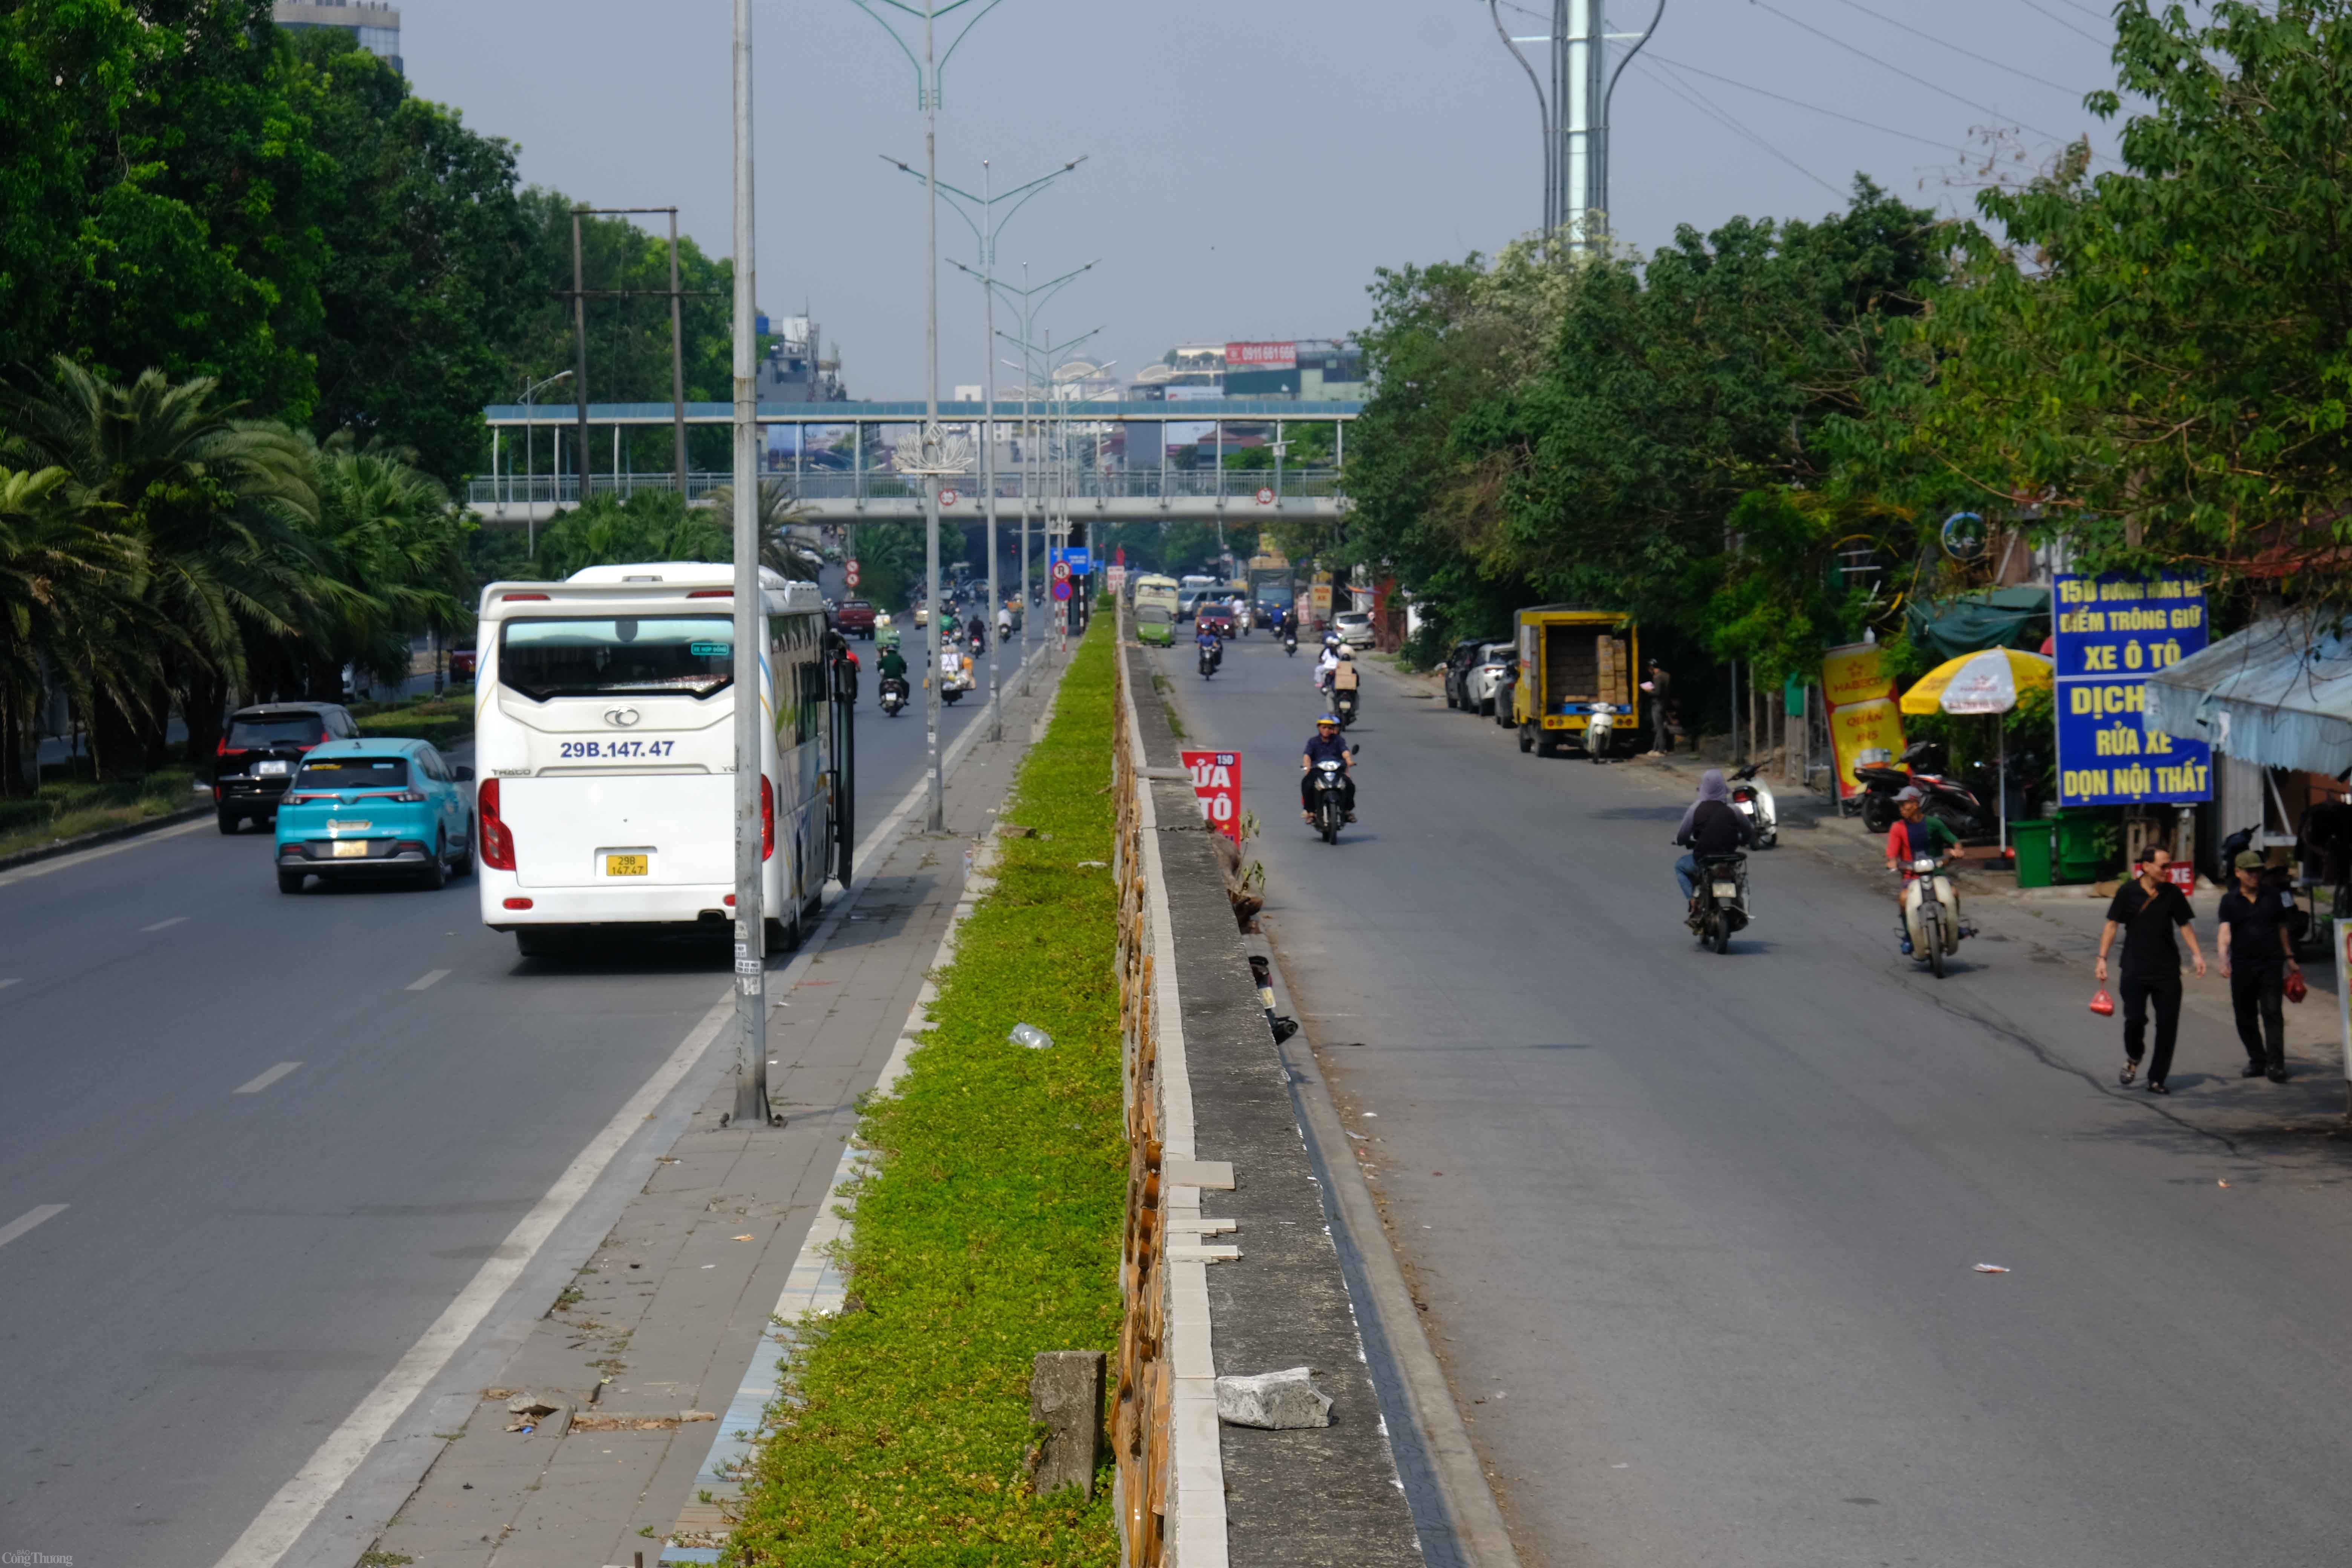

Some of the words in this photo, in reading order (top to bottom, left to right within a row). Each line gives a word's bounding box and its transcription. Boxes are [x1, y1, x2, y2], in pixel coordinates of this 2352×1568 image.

[2171, 605, 2202, 629] GIỮ
[2084, 646, 2118, 671] XE
[2124, 640, 2143, 669] Ô
[2148, 638, 2181, 668] TÔ
[2071, 684, 2145, 720] DỊCH
[2096, 721, 2140, 756] RỬA
[2145, 730, 2173, 754] XE
[1216, 755, 1234, 765] 15D
[2064, 769, 2108, 801] DỌN
[2113, 763, 2151, 799] NỘI
[2155, 756, 2208, 793] THẤT
[612, 866, 644, 875] 147.47
[618, 857, 635, 865] 29B
[2171, 868, 2191, 883] XE
